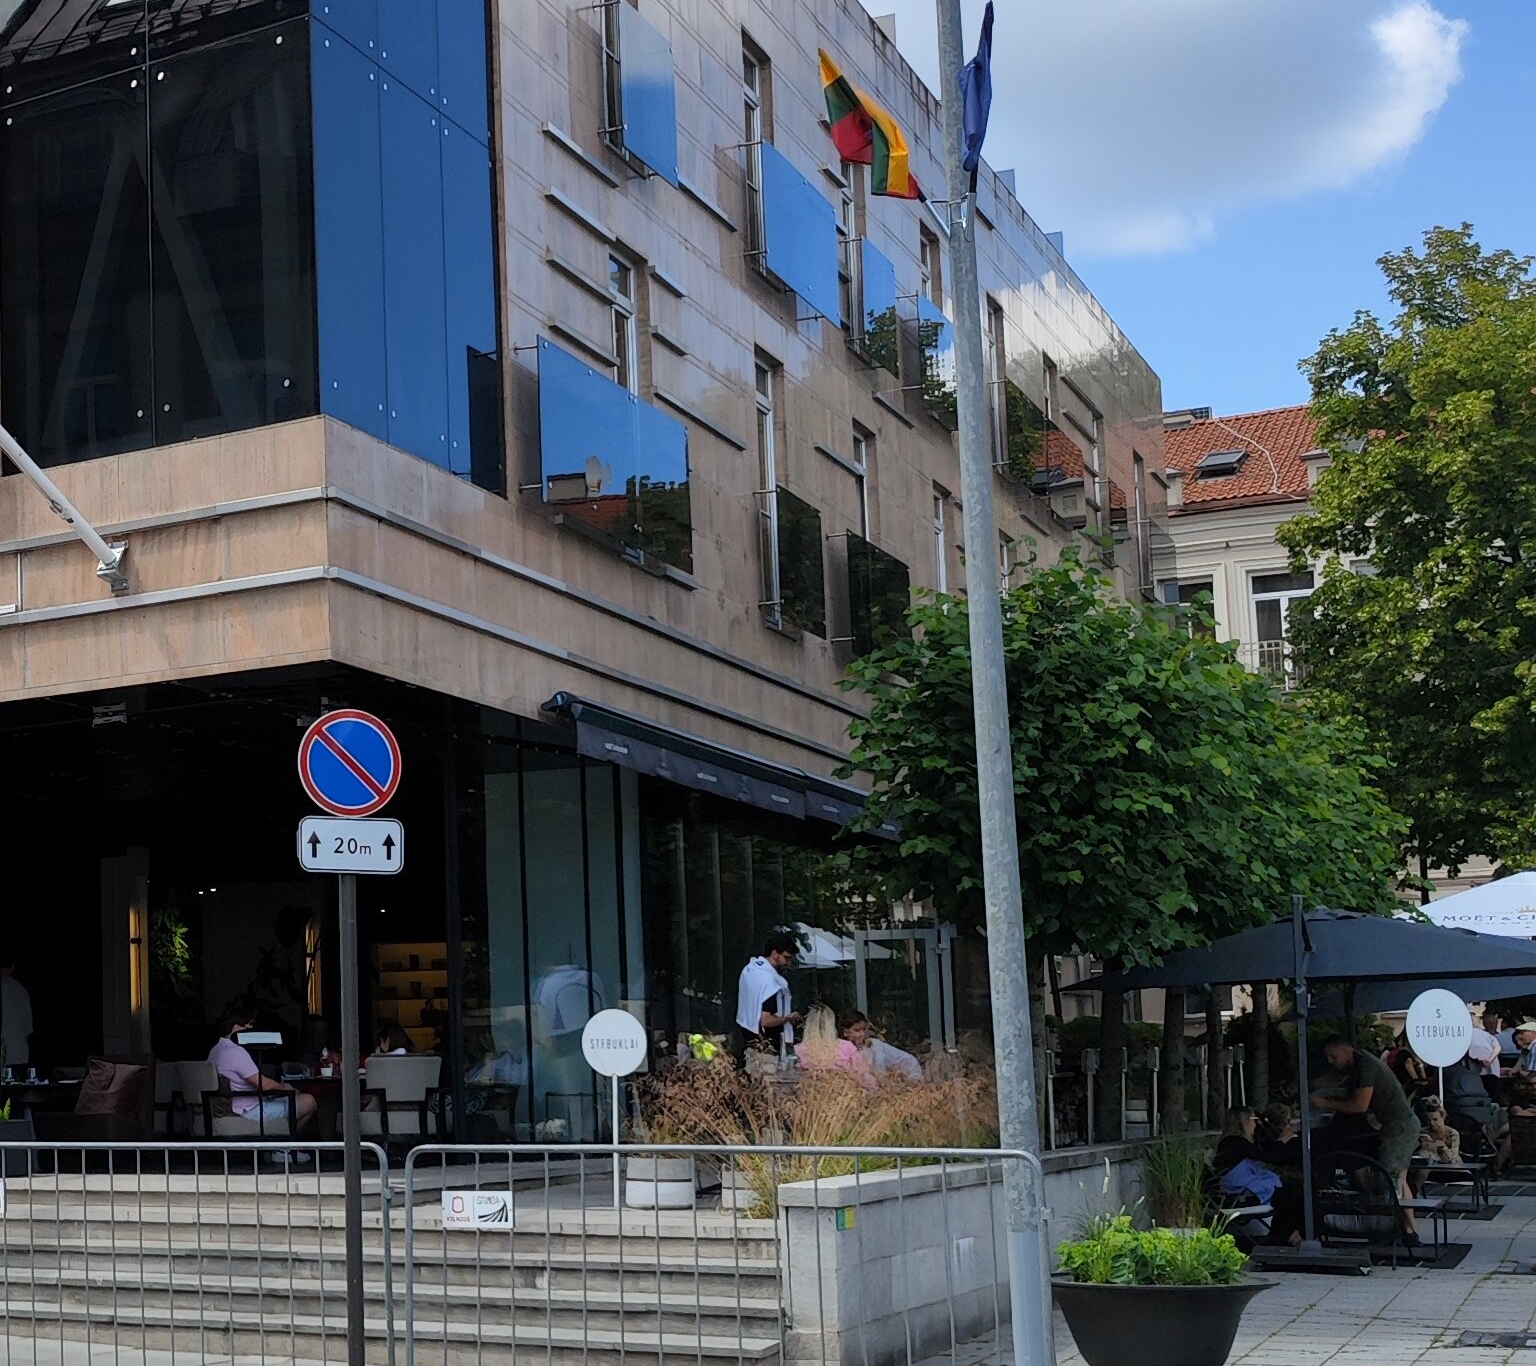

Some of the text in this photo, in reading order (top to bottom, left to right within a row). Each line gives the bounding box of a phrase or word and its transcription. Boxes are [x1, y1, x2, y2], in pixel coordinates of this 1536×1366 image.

[333, 837, 372, 855] 20m
[1415, 1025, 1465, 1038] STEBUKLAI
[589, 1038, 639, 1050] STEBUKLAI
